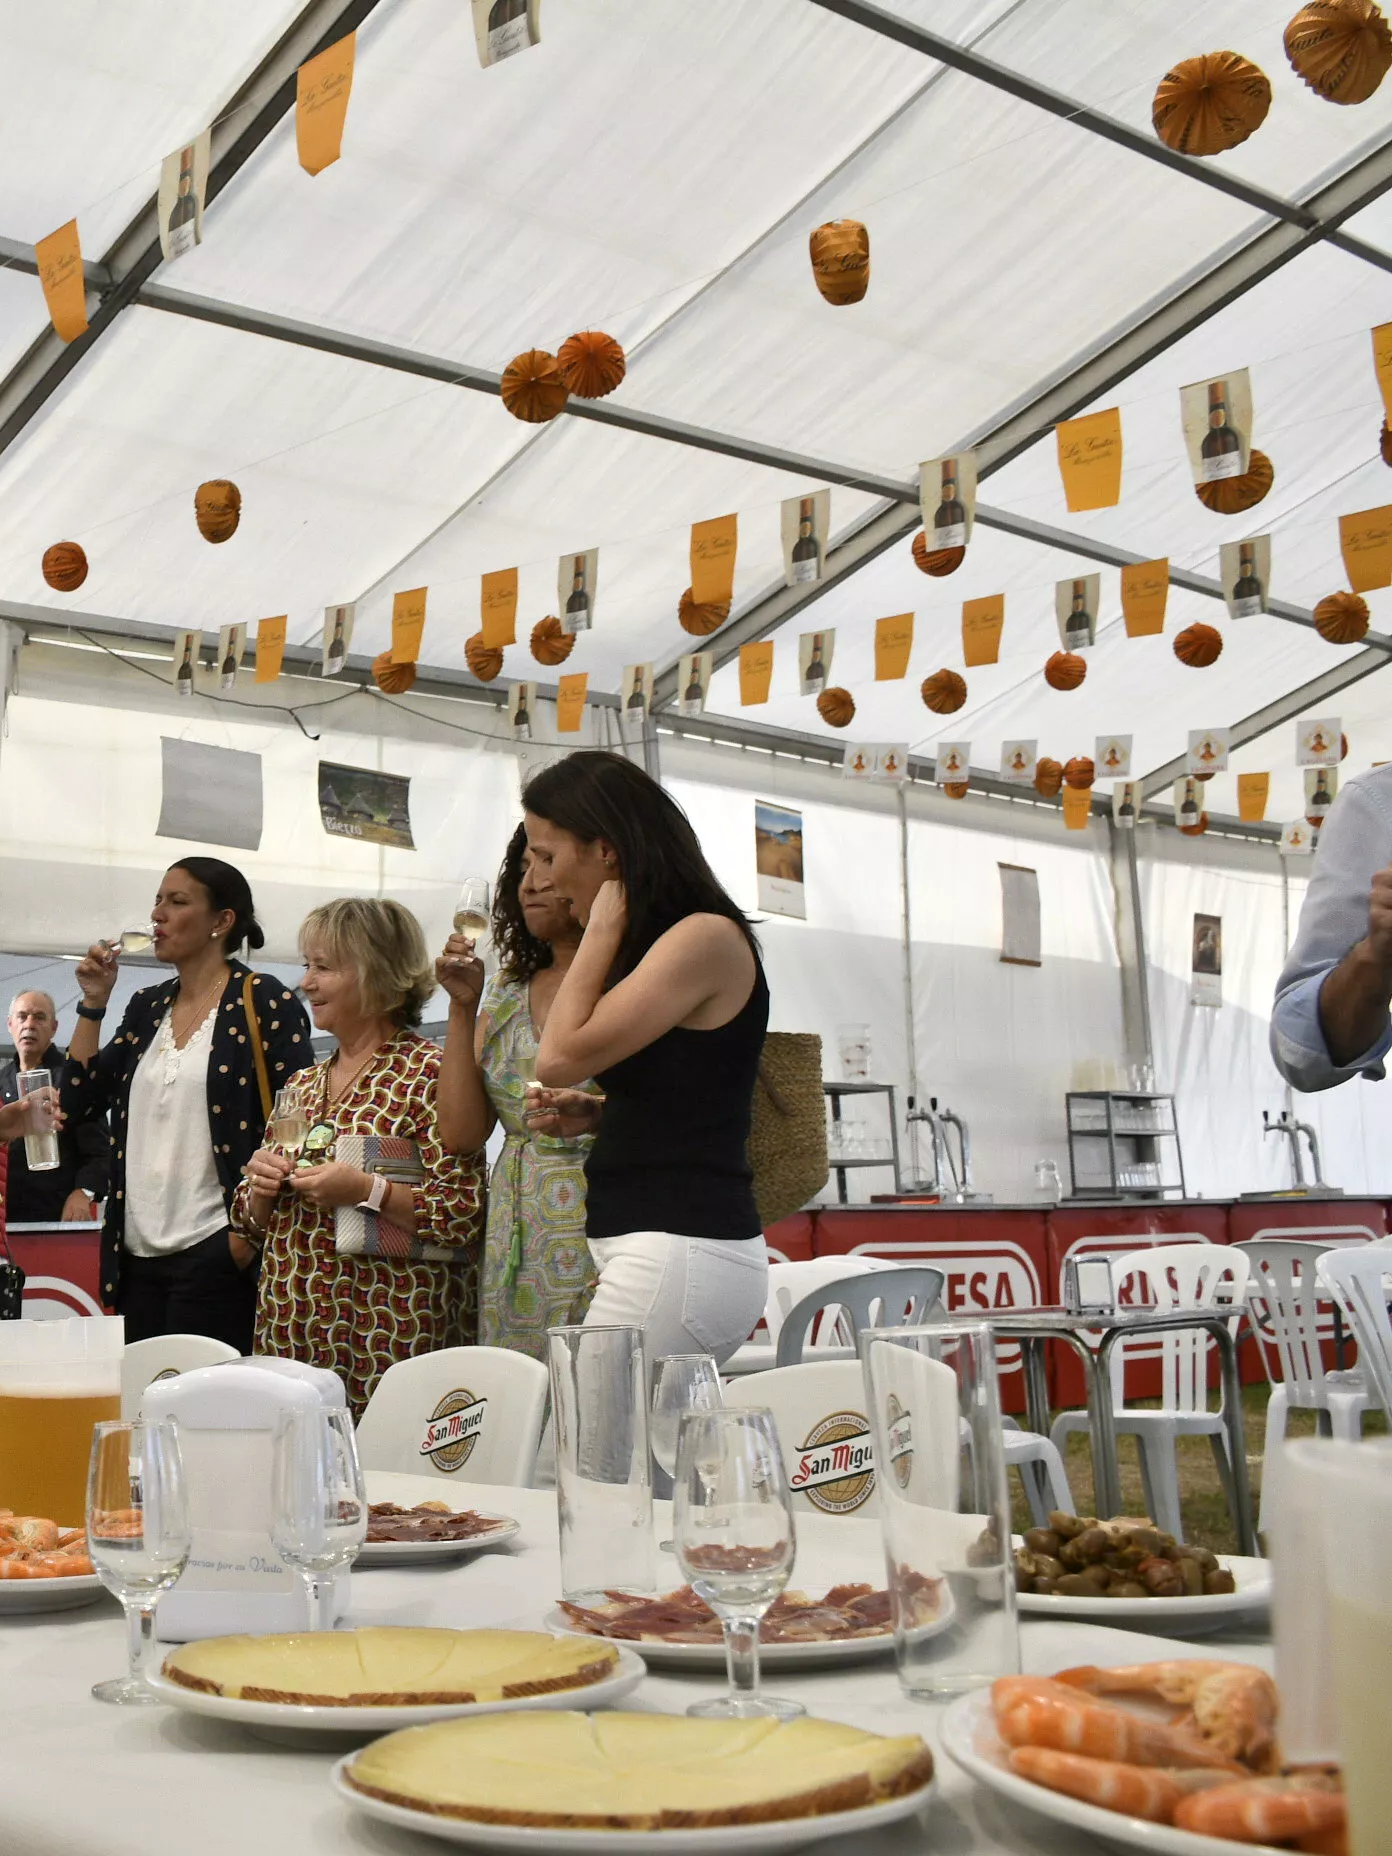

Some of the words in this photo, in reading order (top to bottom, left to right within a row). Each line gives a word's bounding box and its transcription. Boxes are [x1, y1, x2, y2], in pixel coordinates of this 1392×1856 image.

[947, 1272, 1015, 1311] ESA
[422, 1424, 449, 1450] San
[449, 1407, 485, 1438] Miguel
[791, 1454, 831, 1485] San
[831, 1444, 874, 1474] Migu
[186, 1559, 215, 1569] racias
